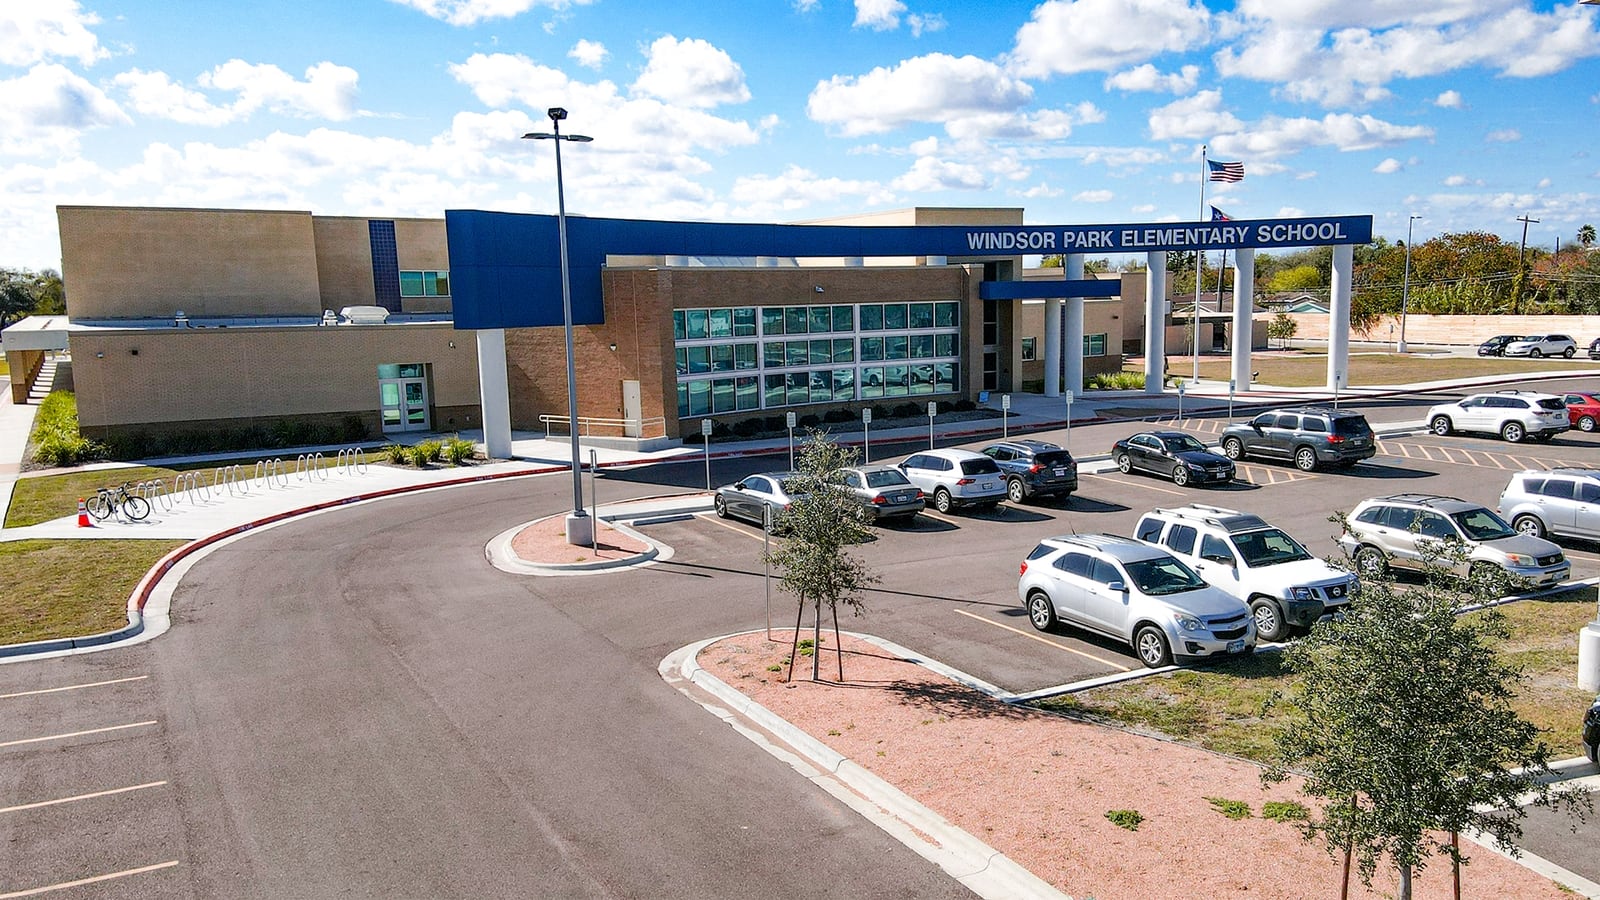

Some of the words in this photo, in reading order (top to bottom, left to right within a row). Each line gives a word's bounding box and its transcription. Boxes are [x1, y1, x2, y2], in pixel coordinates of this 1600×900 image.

[967, 232, 1056, 250] WINDSOR
[1063, 230, 1114, 248] PARK
[1121, 226, 1250, 247] ELEMENTARY
[1256, 222, 1347, 243] SCHOOL
